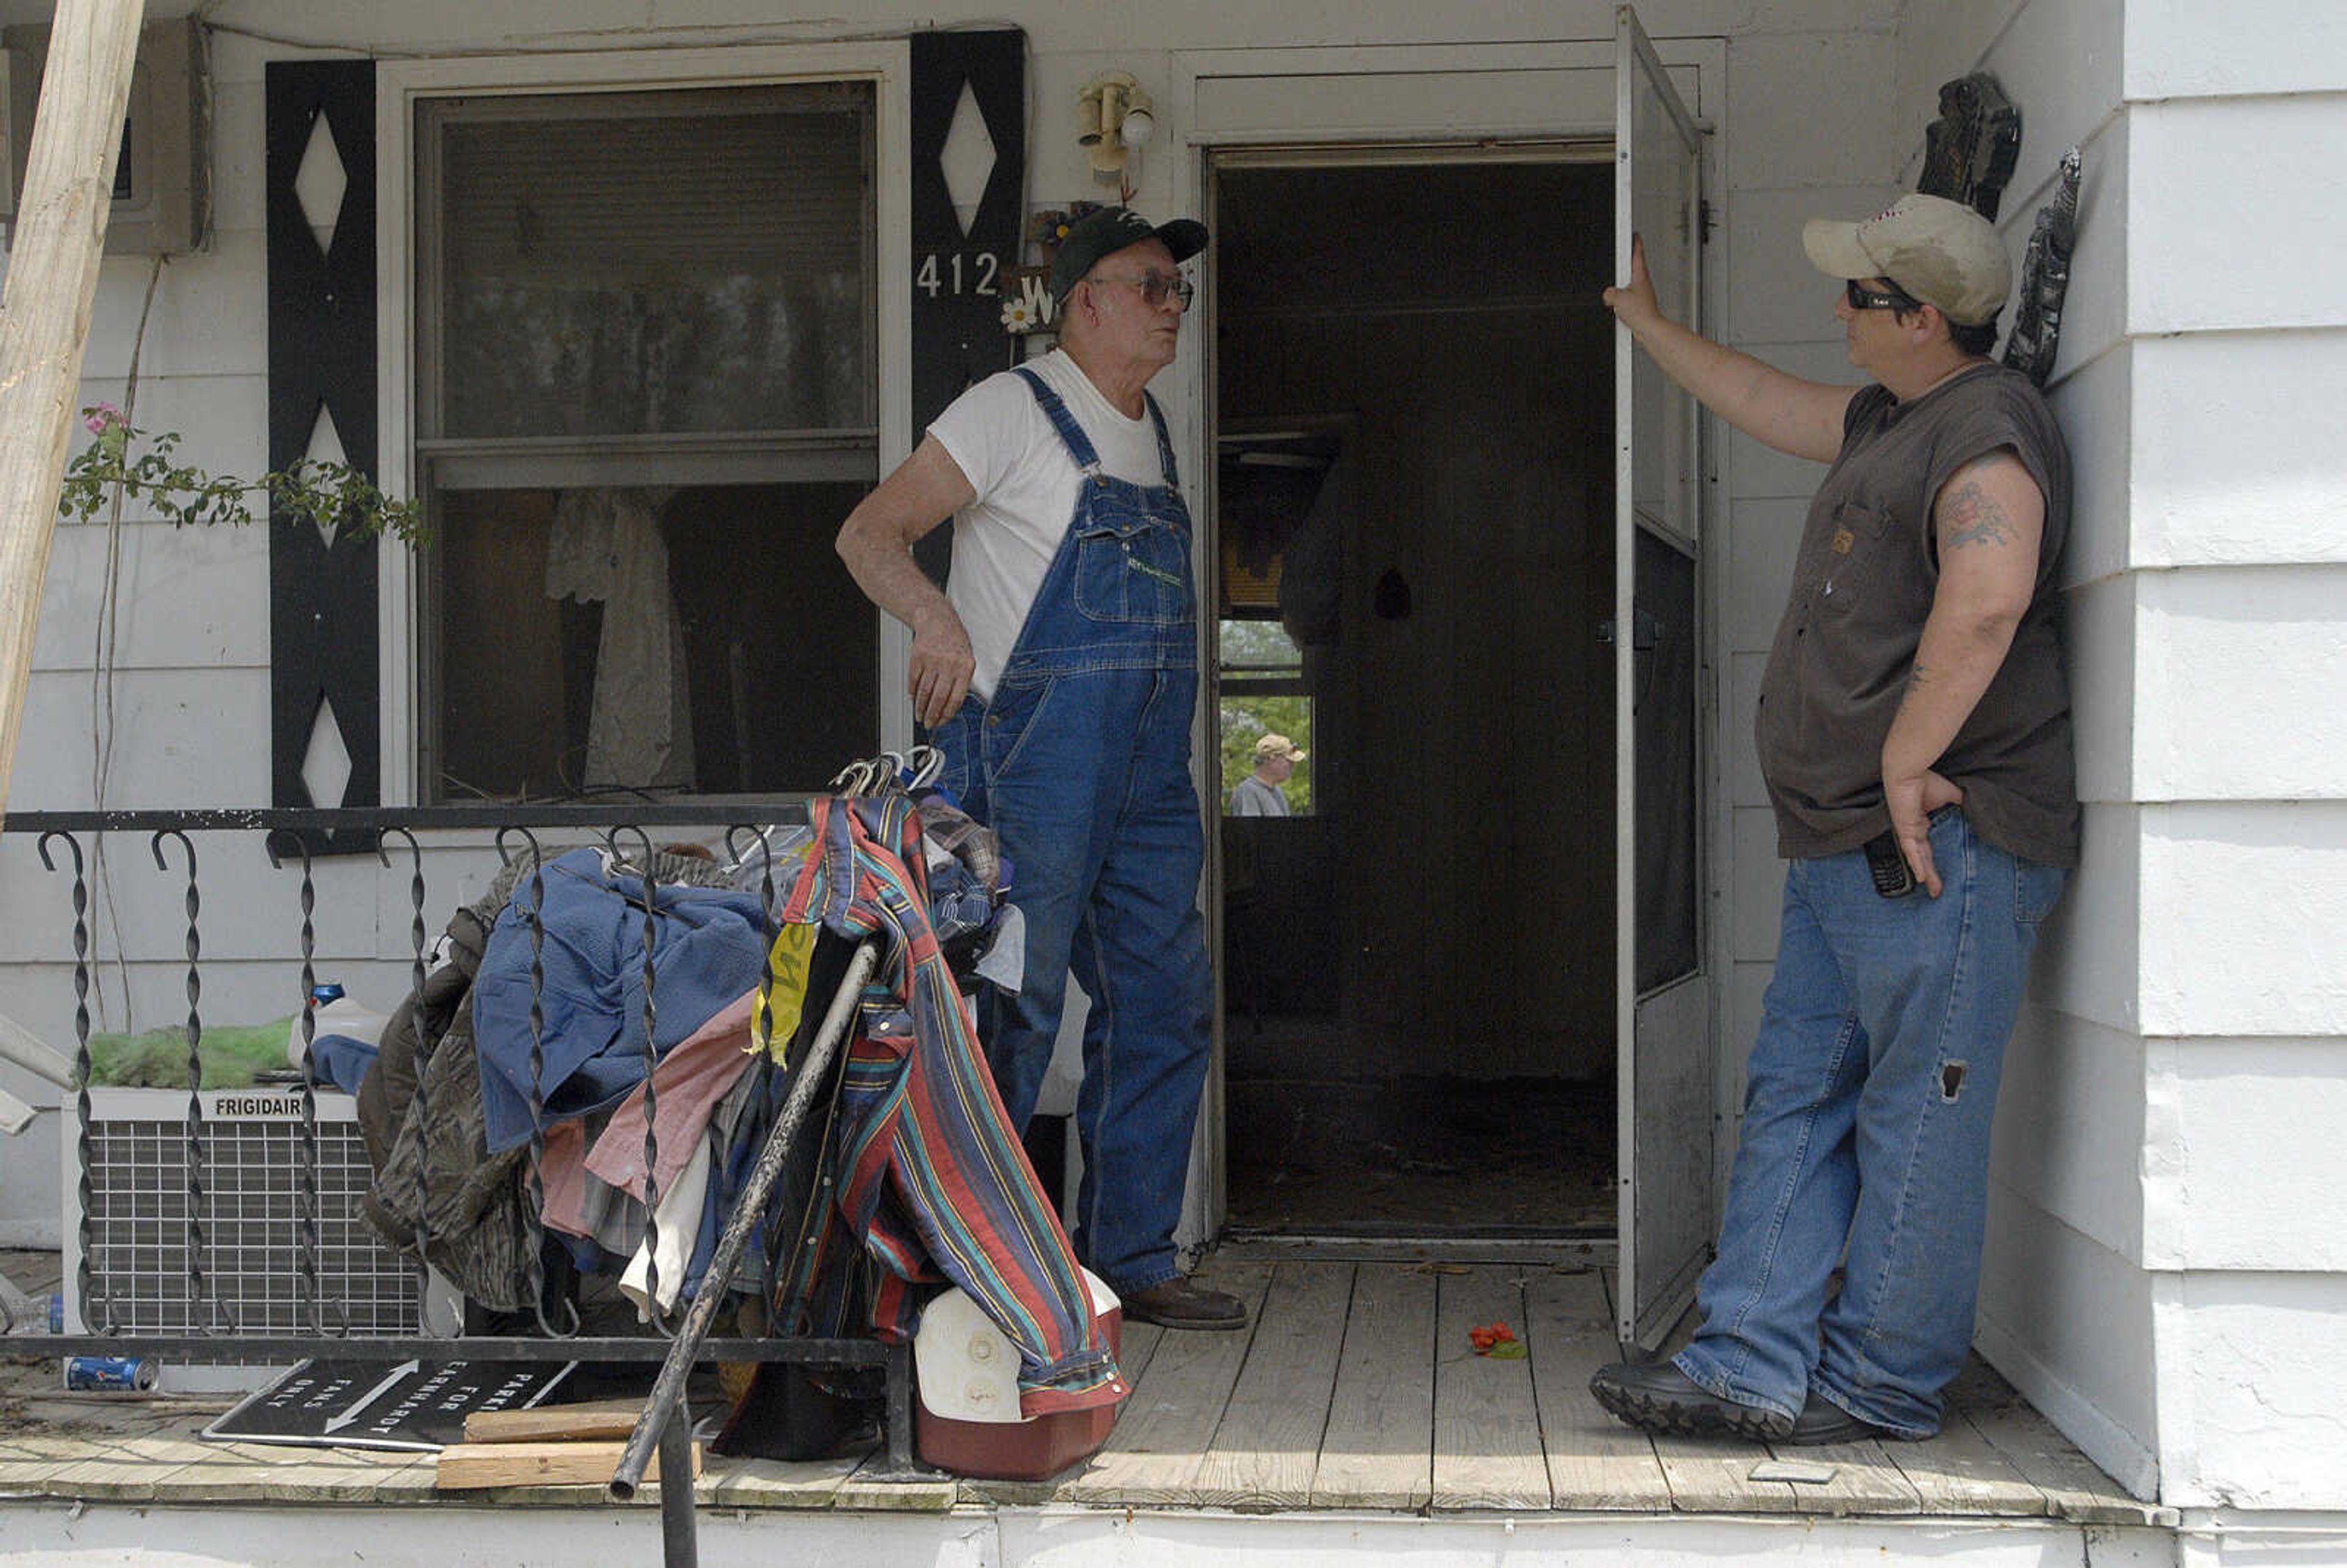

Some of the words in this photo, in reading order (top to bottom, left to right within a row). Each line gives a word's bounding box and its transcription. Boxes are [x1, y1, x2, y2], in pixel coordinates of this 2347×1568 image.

[916, 252, 997, 297] 412
[1020, 276, 1054, 325] W
[216, 1099, 301, 1116] FRIGIDAIR
[267, 1379, 315, 1407] ONLY
[303, 1379, 353, 1408] FANS
[438, 1385, 480, 1410] FOR
[476, 1374, 533, 1414] PARKI
